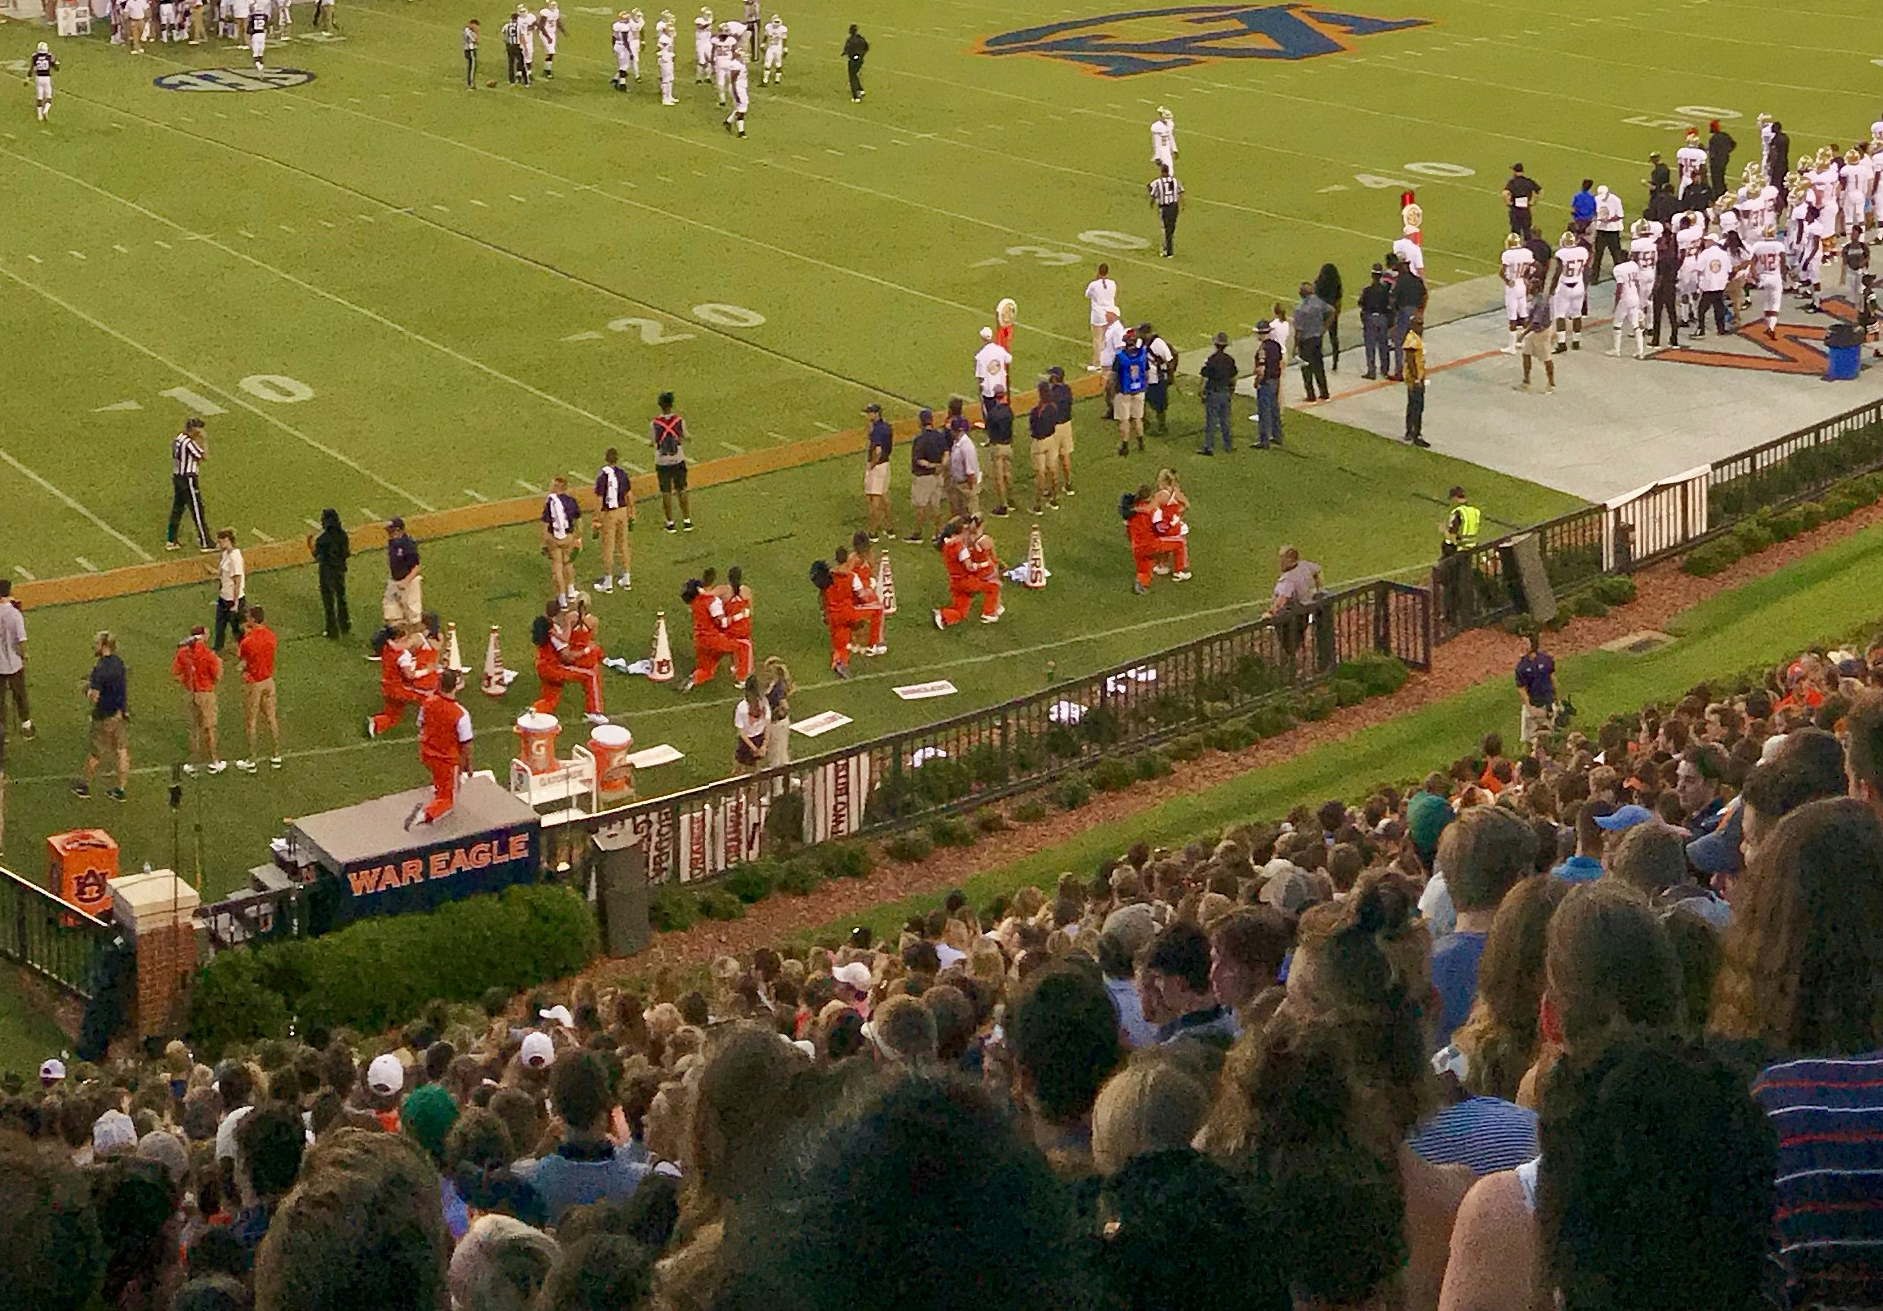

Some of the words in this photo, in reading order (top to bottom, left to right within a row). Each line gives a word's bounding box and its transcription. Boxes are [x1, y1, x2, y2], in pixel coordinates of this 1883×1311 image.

[1621, 104, 1744, 131] 50
[1353, 161, 1476, 189] 40
[1003, 229, 1150, 267] 30
[1566, 259, 1584, 278] 67
[1760, 253, 1776, 272] 42
[606, 301, 767, 348] 20
[157, 372, 315, 418] 10
[530, 738, 546, 757] G
[346, 858, 425, 898] WAR
[428, 831, 532, 881] EAGLE
